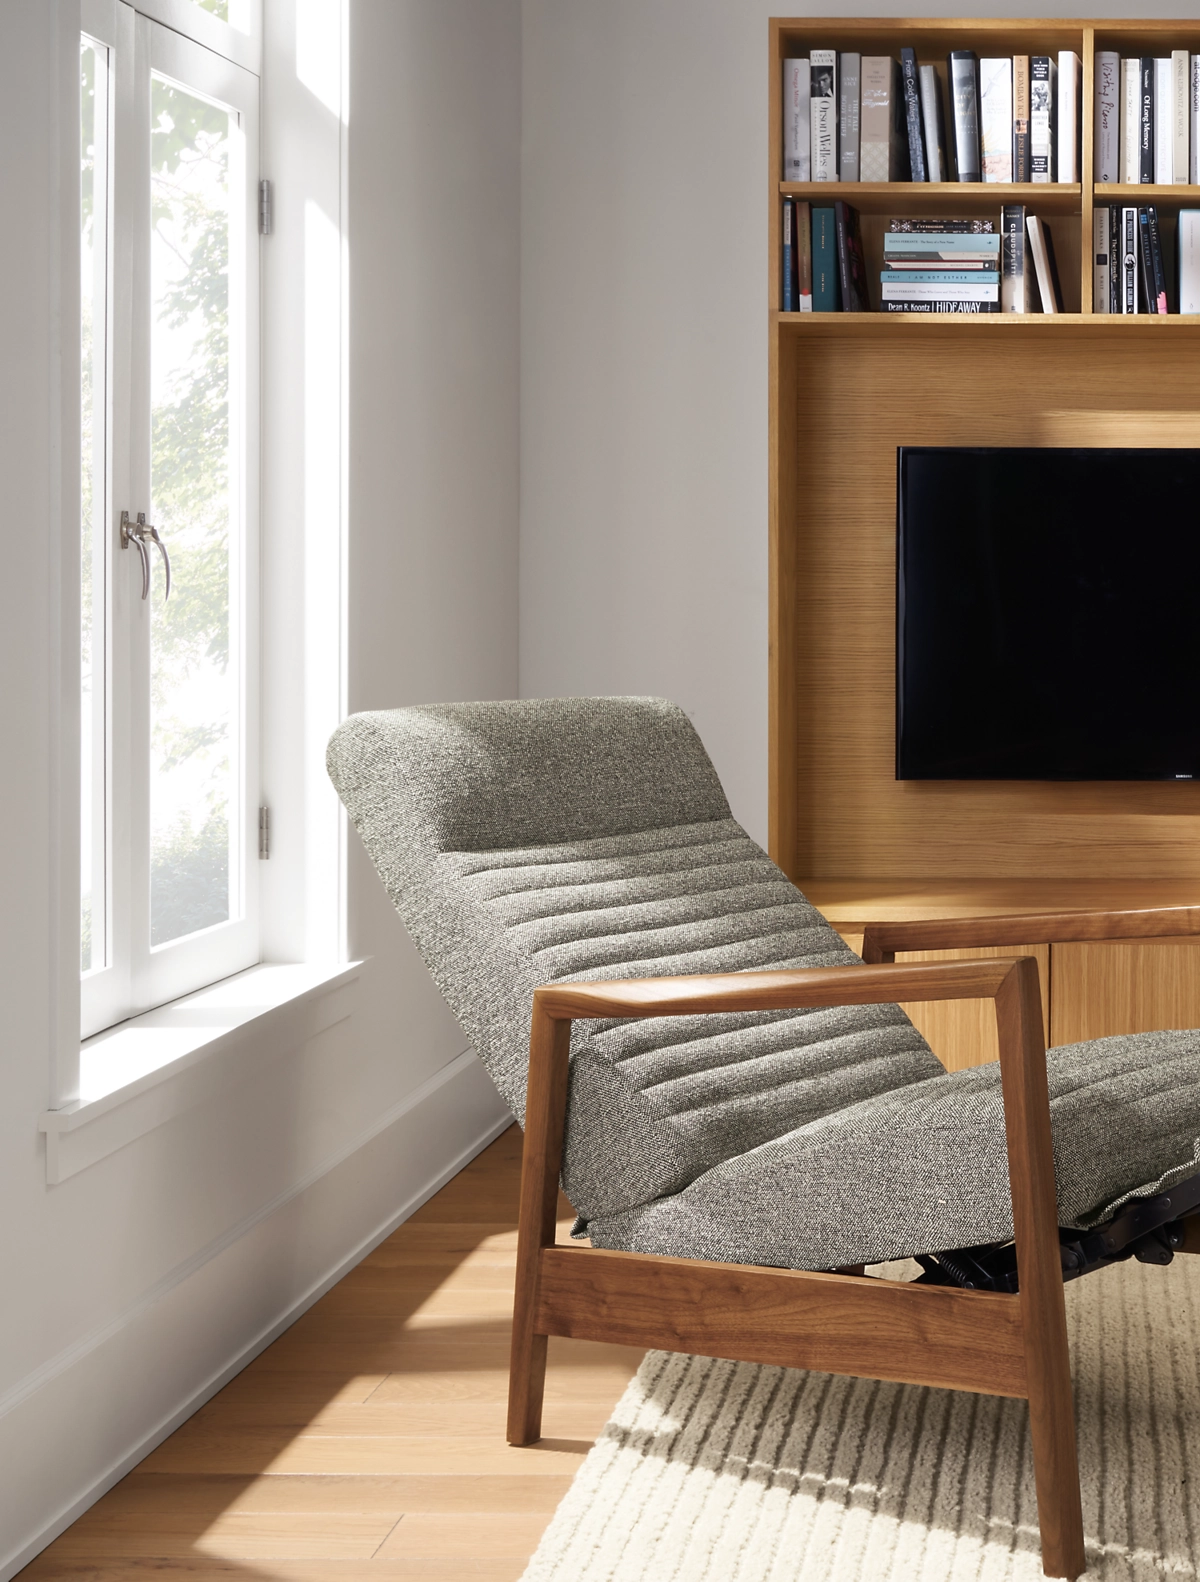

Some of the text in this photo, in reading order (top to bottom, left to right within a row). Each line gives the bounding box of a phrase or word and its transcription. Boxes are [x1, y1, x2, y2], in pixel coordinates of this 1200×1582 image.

[792, 67, 800, 89] Omega
[905, 59, 913, 77] From
[906, 78, 915, 96] Cold
[1098, 62, 1115, 130] Visiting Picasso
[1192, 61, 1200, 112] at-edge.com
[908, 96, 917, 122] Waters
[1144, 95, 1151, 105] Of
[1142, 105, 1151, 122] Long
[1177, 109, 1184, 118] AT
[819, 100, 831, 167] Orson Welles
[1142, 123, 1151, 150] Memory
[1149, 219, 1157, 244] Sister
[1143, 234, 1151, 266] DIETRICH
[888, 301, 981, 313] Dean R. Koontz HIDEAWAY
